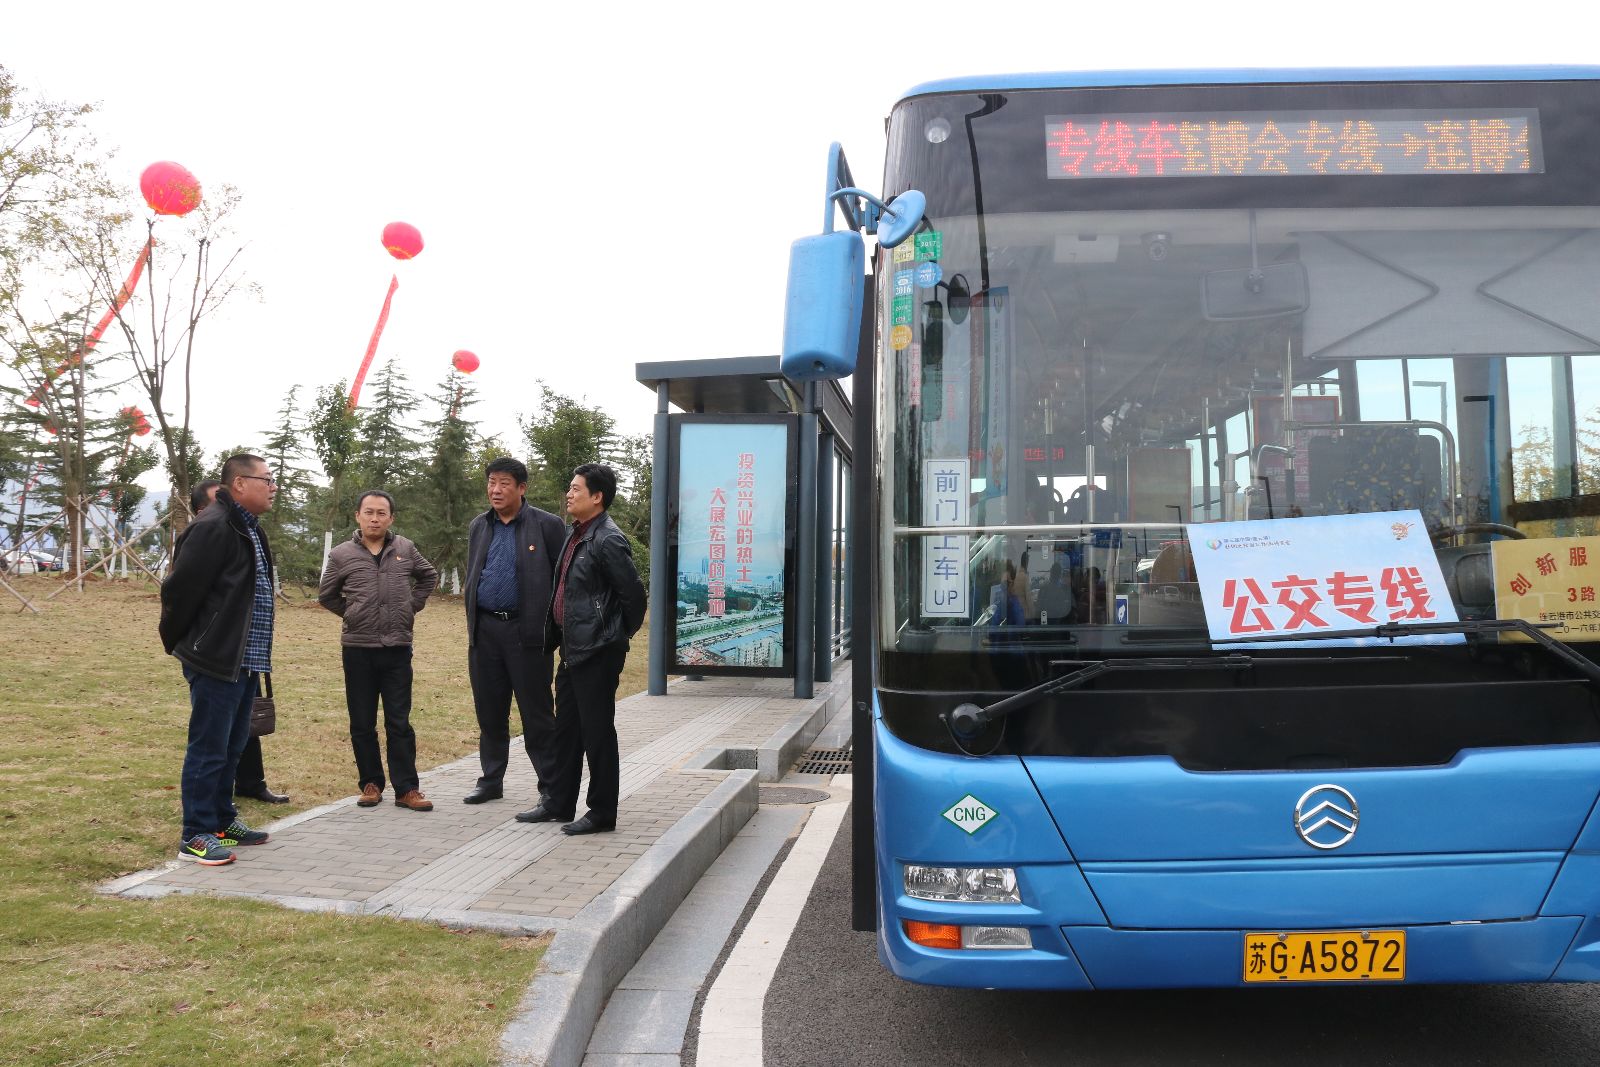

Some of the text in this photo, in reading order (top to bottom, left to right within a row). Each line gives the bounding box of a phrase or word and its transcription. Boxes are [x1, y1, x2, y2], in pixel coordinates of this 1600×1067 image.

[735, 452, 755, 584] 投资兴业的热土
[933, 469, 960, 580] 前门上车
[707, 487, 728, 618] 大展宏图的宝地
[934, 589, 958, 606] UP
[1222, 566, 1438, 634] 公交专线
[953, 806, 986, 822] CNG
[1249, 939, 1401, 974] 苏G·A5872
